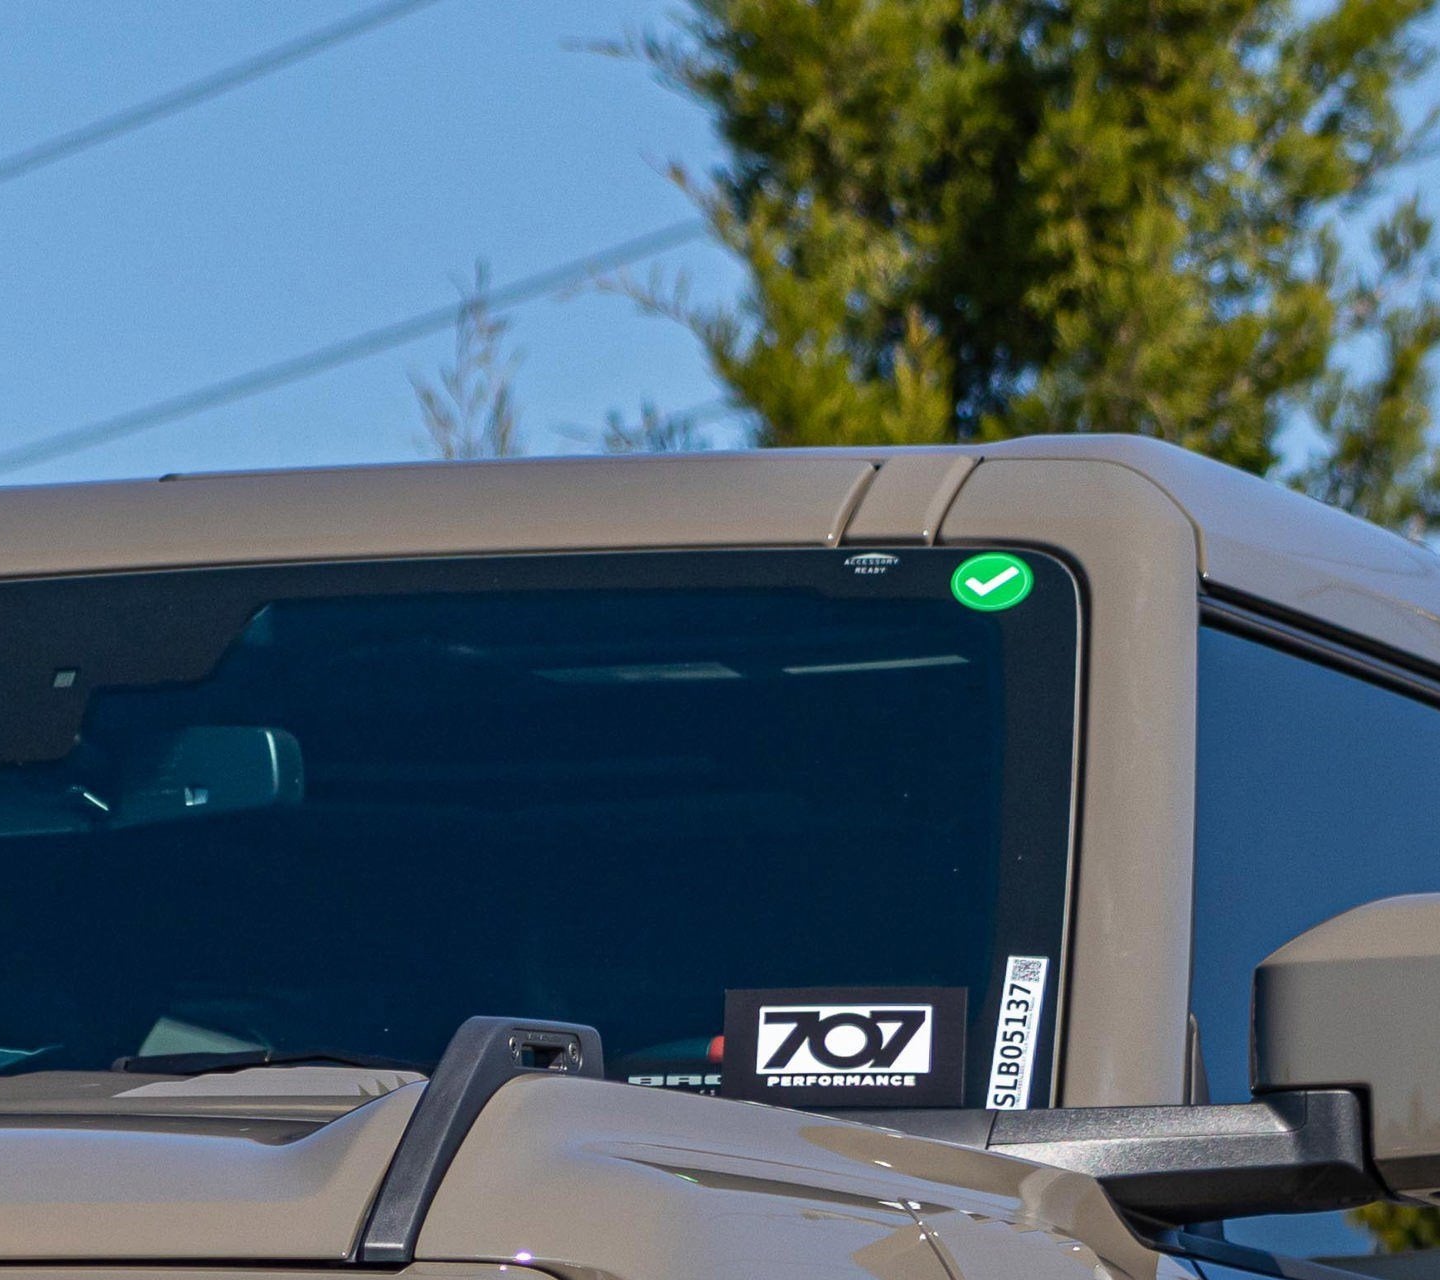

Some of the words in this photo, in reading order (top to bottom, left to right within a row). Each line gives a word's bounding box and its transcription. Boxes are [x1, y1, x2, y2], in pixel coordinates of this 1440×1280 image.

[763, 1010, 926, 1070] 707
[993, 983, 1032, 1108] SLB05137
[766, 1074, 917, 1087] PERFORMANCE
